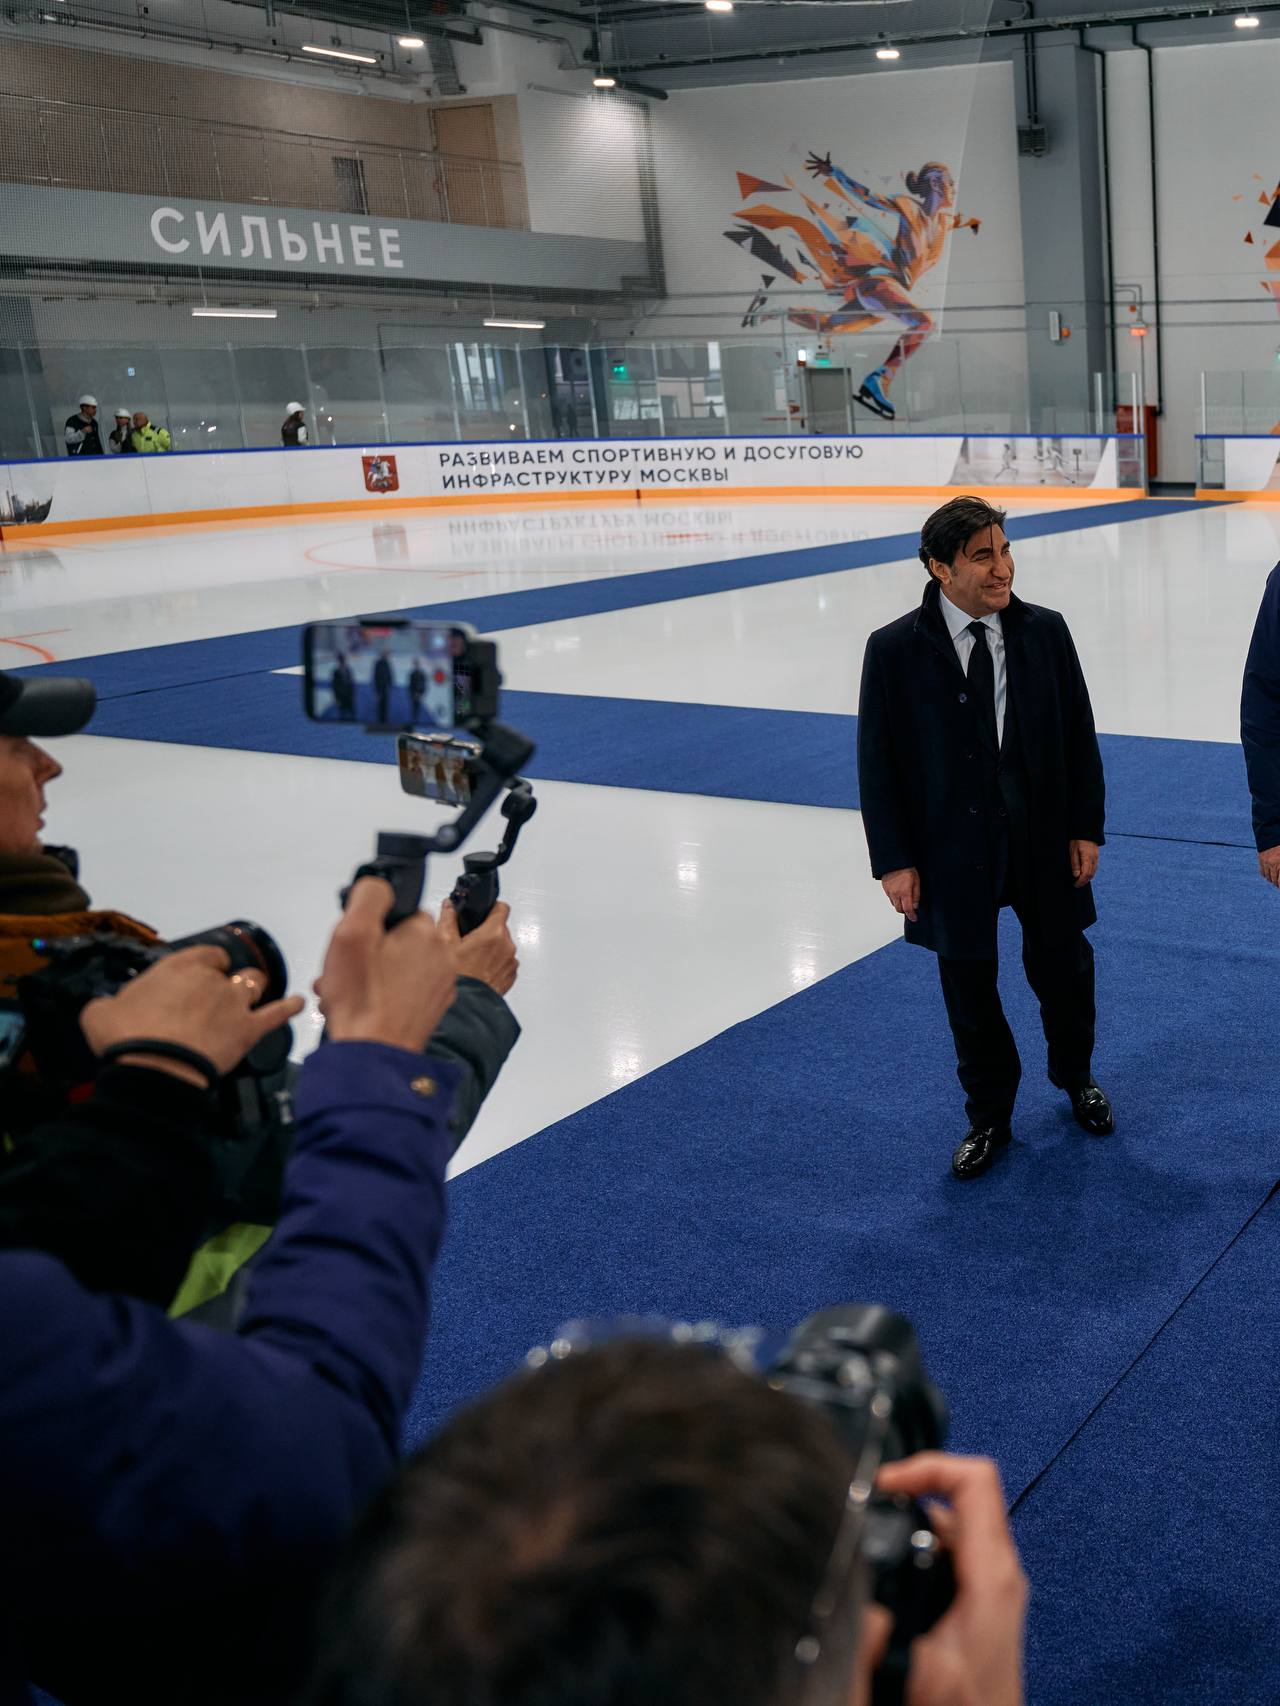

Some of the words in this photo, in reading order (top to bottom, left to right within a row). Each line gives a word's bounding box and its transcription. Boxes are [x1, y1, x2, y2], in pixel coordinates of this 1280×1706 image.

[150, 206, 404, 268] СИЛЬНЕЕ
[439, 449, 564, 467] РАЗВИВАЕМ
[572, 447, 716, 464] СПОРТИВНУЮ
[724, 447, 736, 460] И
[744, 445, 863, 462] ДОСУГОВУЮ
[442, 470, 632, 489] ИНФРАСТРУКТУРУ
[640, 468, 728, 483] МОСКВЫ
